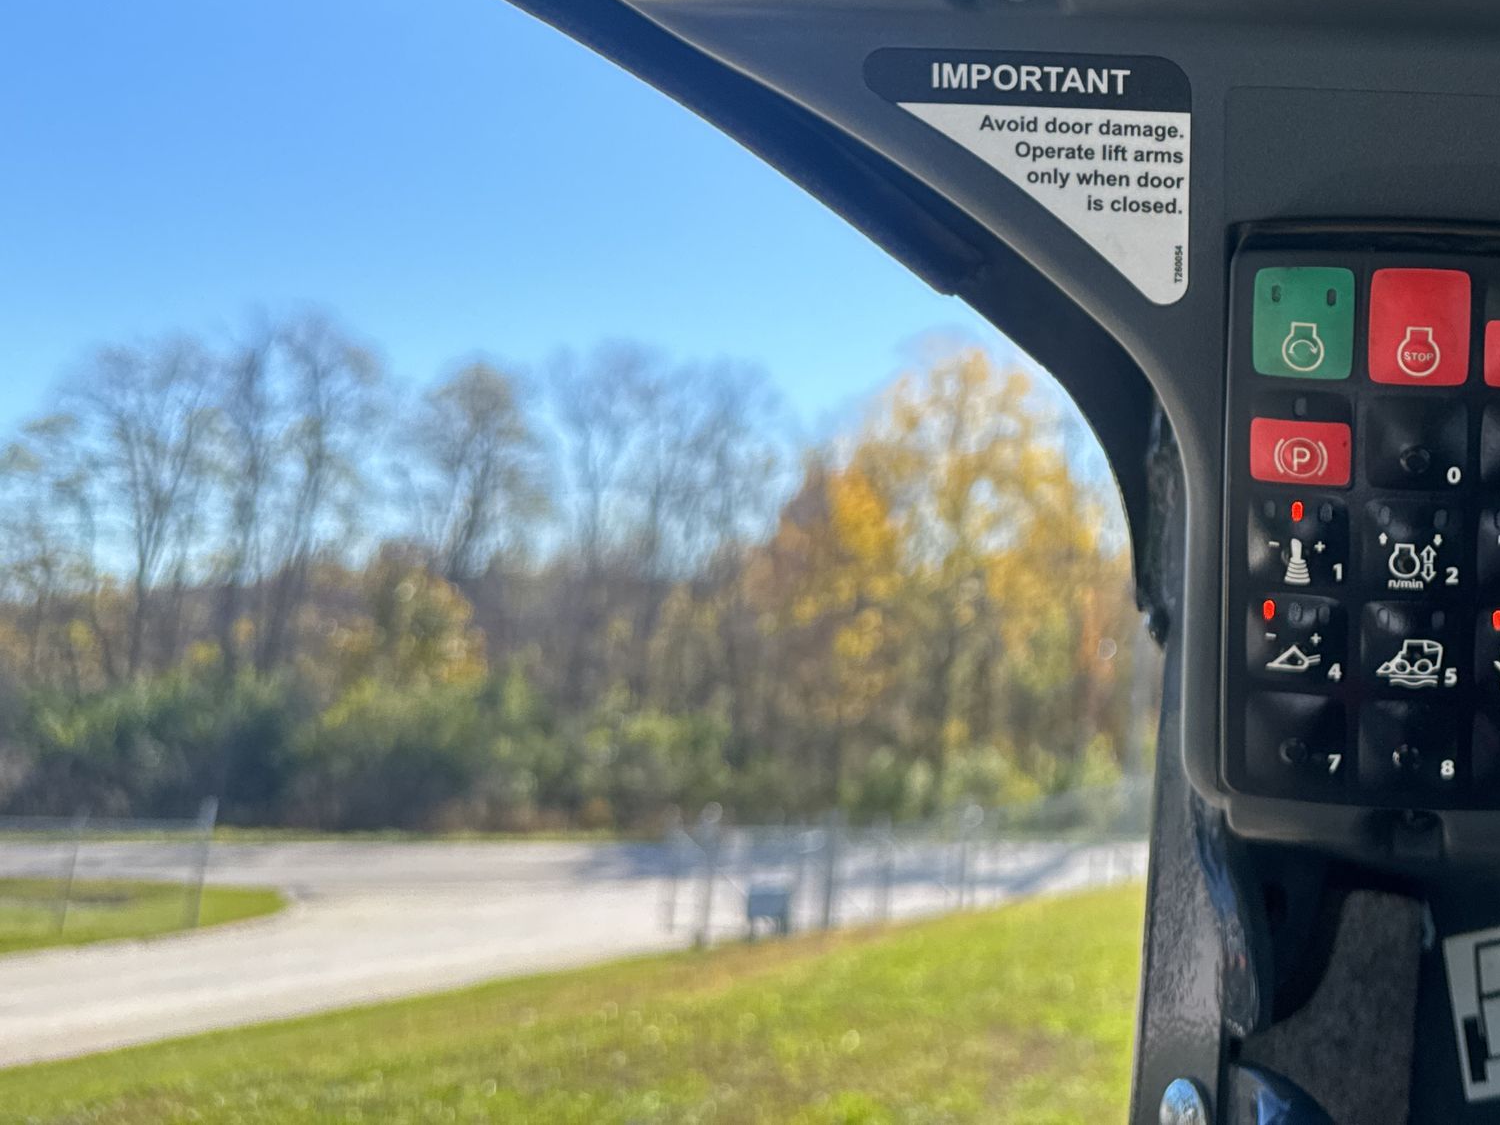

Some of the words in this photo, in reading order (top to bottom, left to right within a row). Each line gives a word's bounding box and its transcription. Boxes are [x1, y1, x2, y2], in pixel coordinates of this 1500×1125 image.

[931, 62, 1132, 96] IMPORTANT
[979, 114, 1039, 133] Avoid
[1044, 117, 1093, 135] door
[1098, 120, 1185, 142] damage.
[1014, 141, 1095, 161] Operate
[1102, 144, 1128, 162] lift
[1133, 149, 1184, 164] arms
[1027, 169, 1071, 188] only
[1076, 170, 1130, 188] when
[1136, 172, 1184, 189] door
[1087, 195, 1104, 212] is
[1109, 196, 1183, 215] closed.
[1404, 351, 1434, 363] STOP
[1292, 447, 1311, 471] P
[1446, 466, 1462, 485] 0
[1332, 562, 1343, 581] 1
[1445, 566, 1459, 585] 2
[1387, 578, 1424, 590] n/min
[1327, 663, 1342, 681] 4
[1443, 667, 1458, 686] 5
[1327, 754, 1342, 774] 7
[1440, 759, 1455, 779] 8
